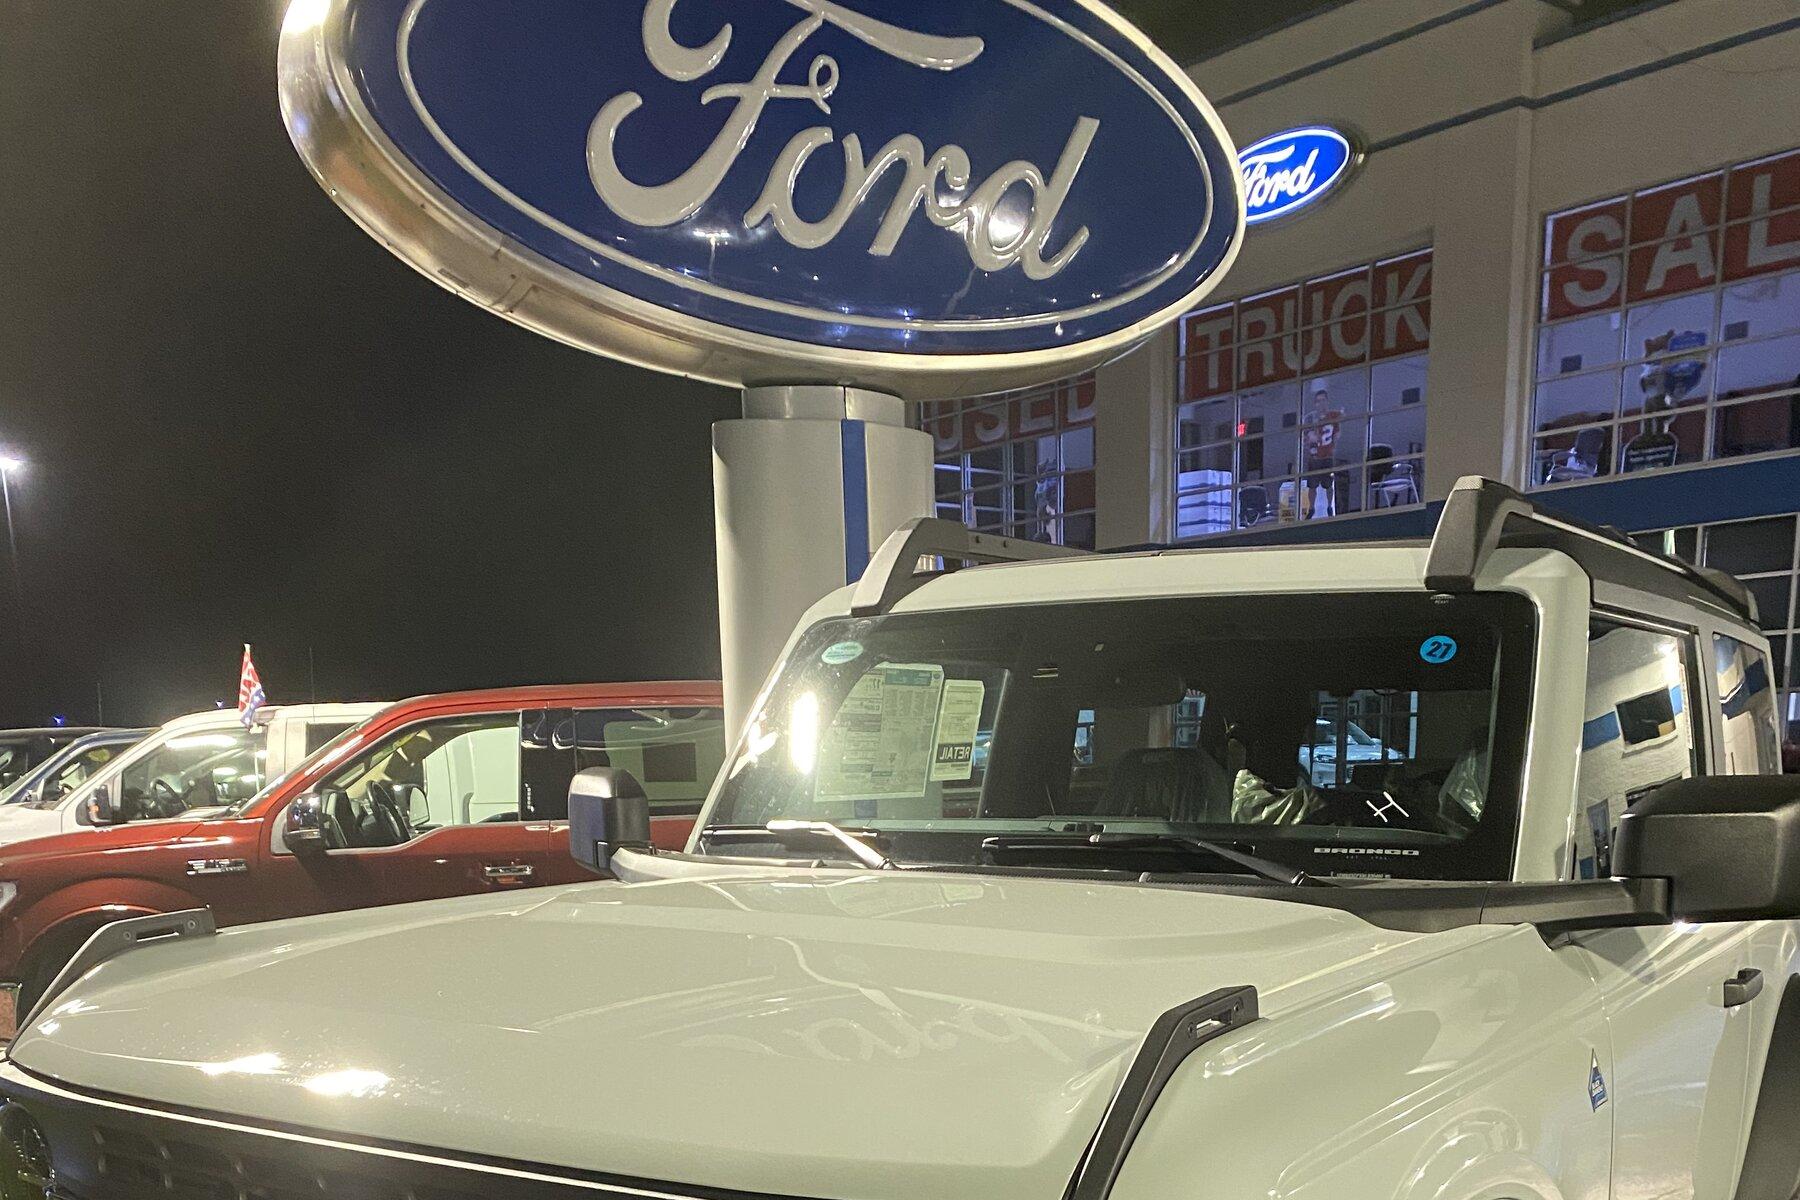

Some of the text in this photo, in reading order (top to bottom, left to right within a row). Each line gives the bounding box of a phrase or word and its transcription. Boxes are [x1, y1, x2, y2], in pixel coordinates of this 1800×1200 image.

[586, 0, 1100, 280] Ford
[1196, 262, 1432, 390] TRUCK
[1562, 173, 1800, 308] SAL
[1426, 640, 1453, 659] 27
[1313, 847, 1420, 856] BRONCO
